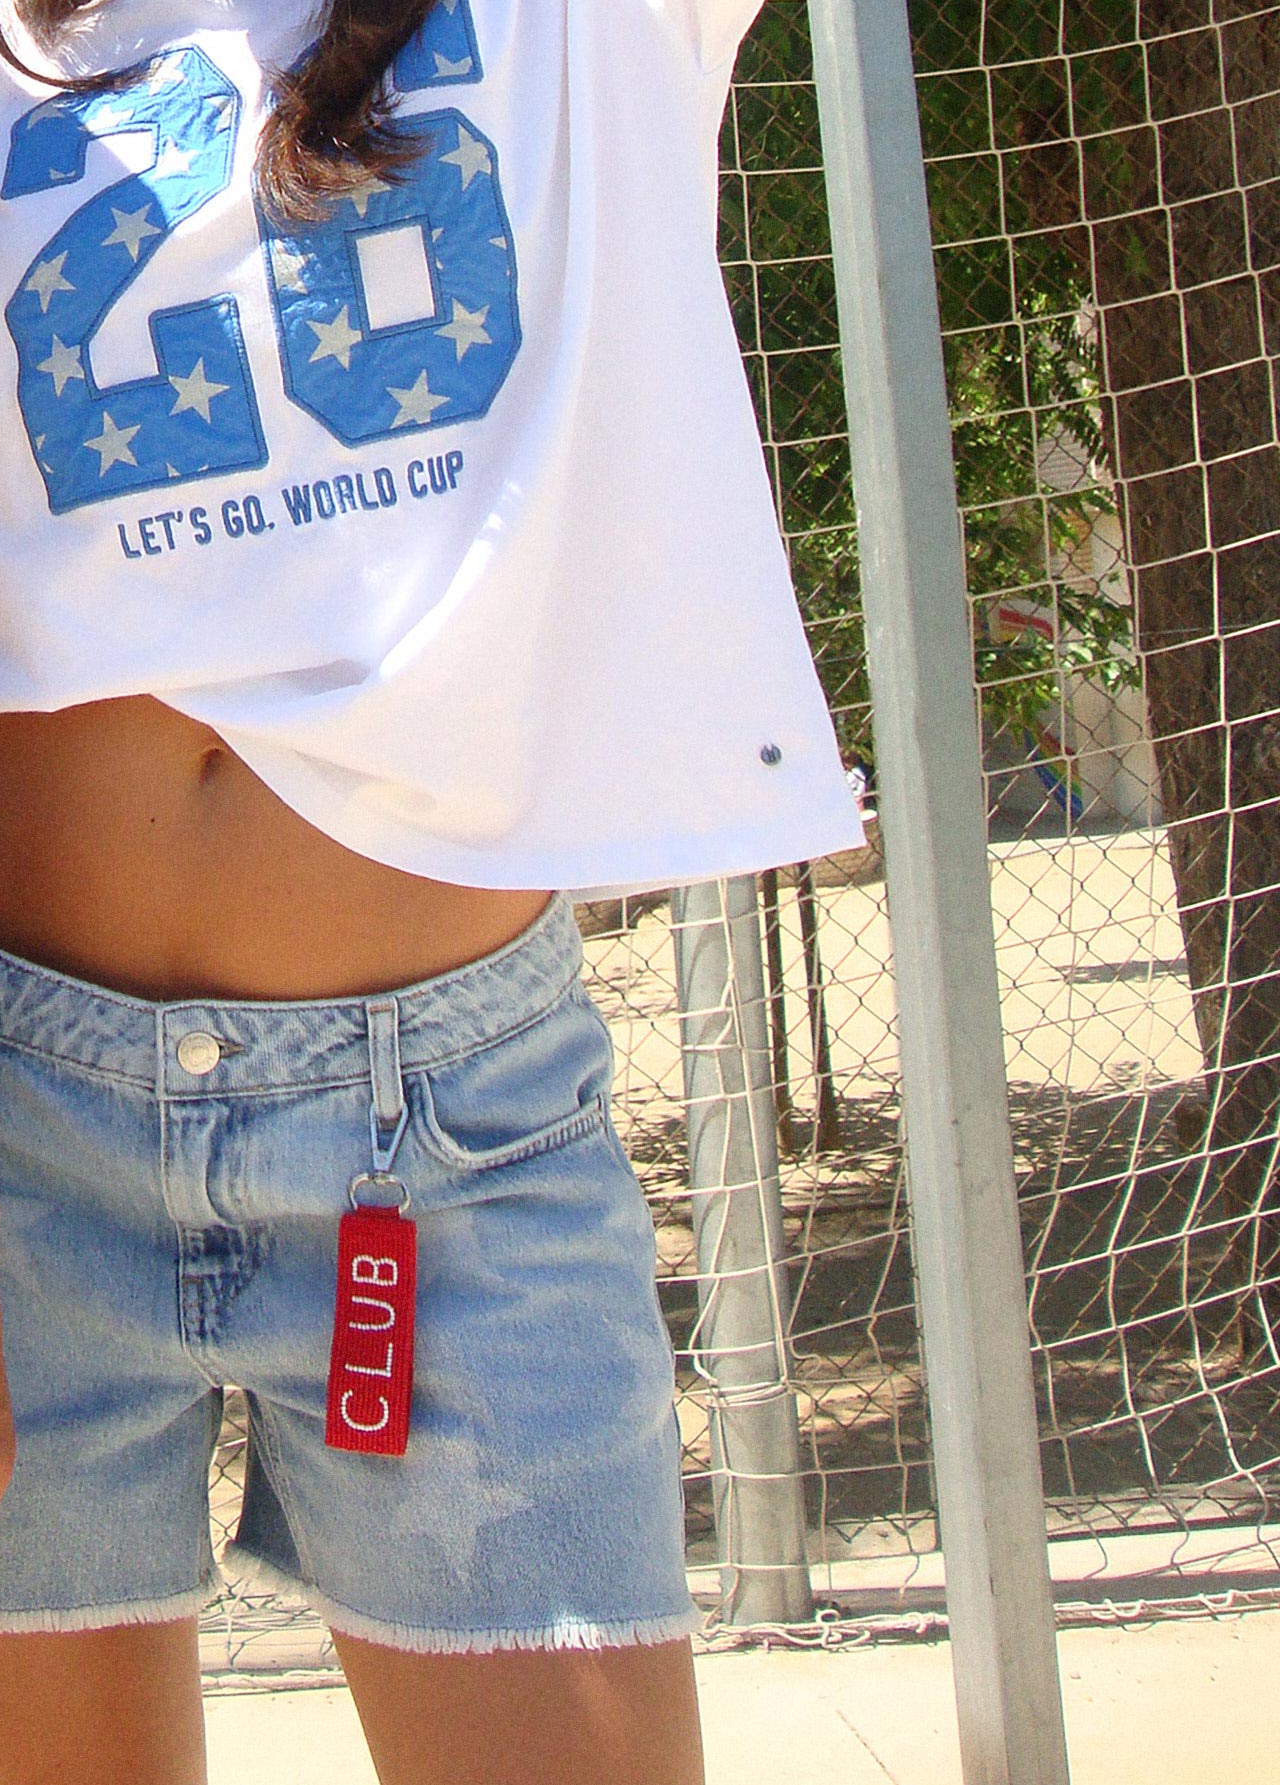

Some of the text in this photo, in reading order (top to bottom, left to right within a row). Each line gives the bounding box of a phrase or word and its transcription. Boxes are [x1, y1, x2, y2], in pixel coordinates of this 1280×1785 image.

[117, 449, 465, 559] LET'S GO. WORLD CUP
[340, 1254, 399, 1432] CLUB
